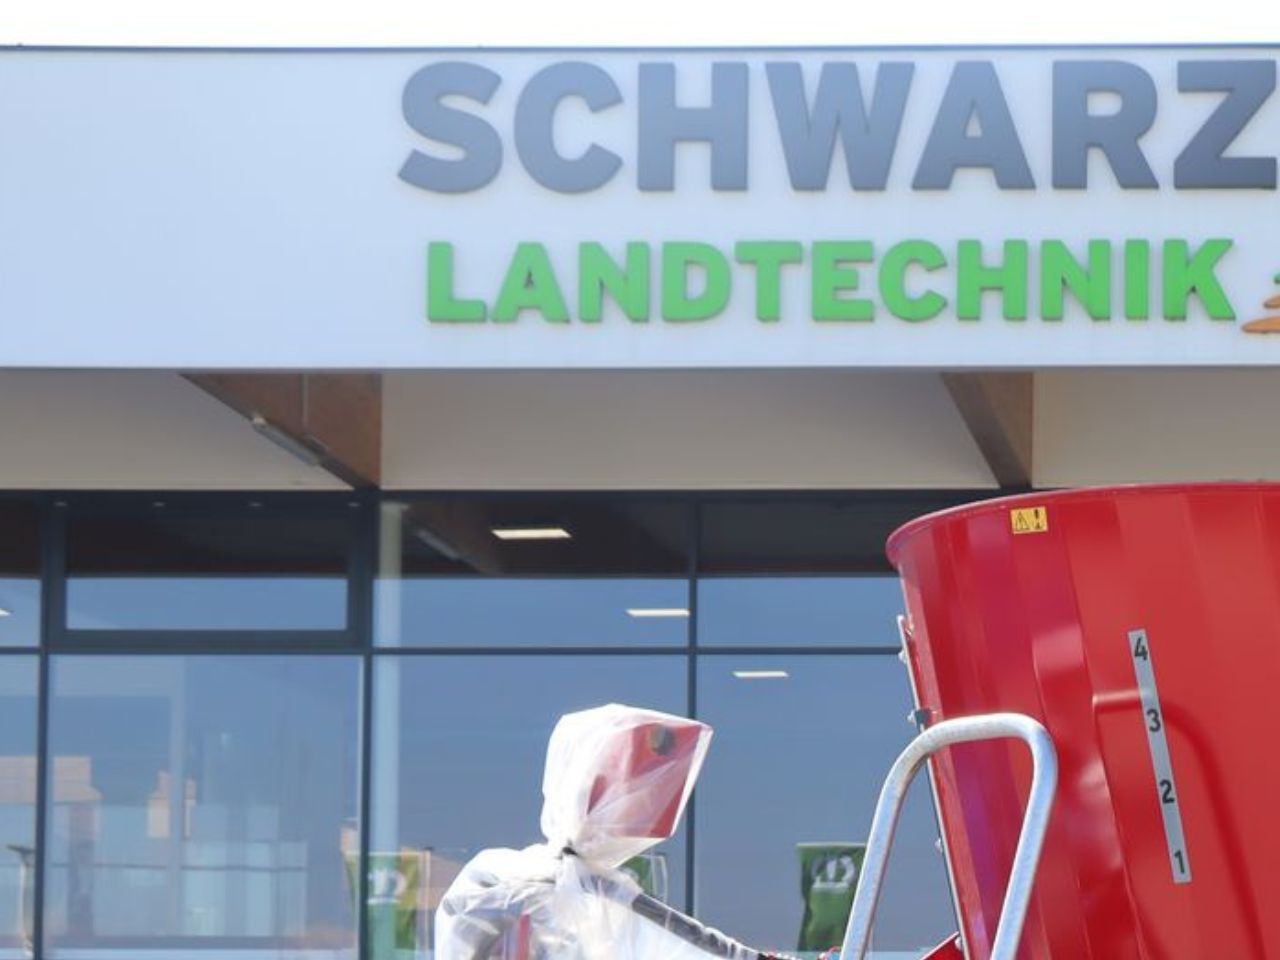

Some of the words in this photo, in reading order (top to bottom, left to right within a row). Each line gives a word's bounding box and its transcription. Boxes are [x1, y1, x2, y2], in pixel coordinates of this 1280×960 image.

[426, 239, 1236, 325] LANDTECHNIK
[1133, 636, 1148, 662] 4
[1146, 708, 1162, 733] 3
[1159, 779, 1176, 804] 2
[1173, 850, 1186, 875] 1
